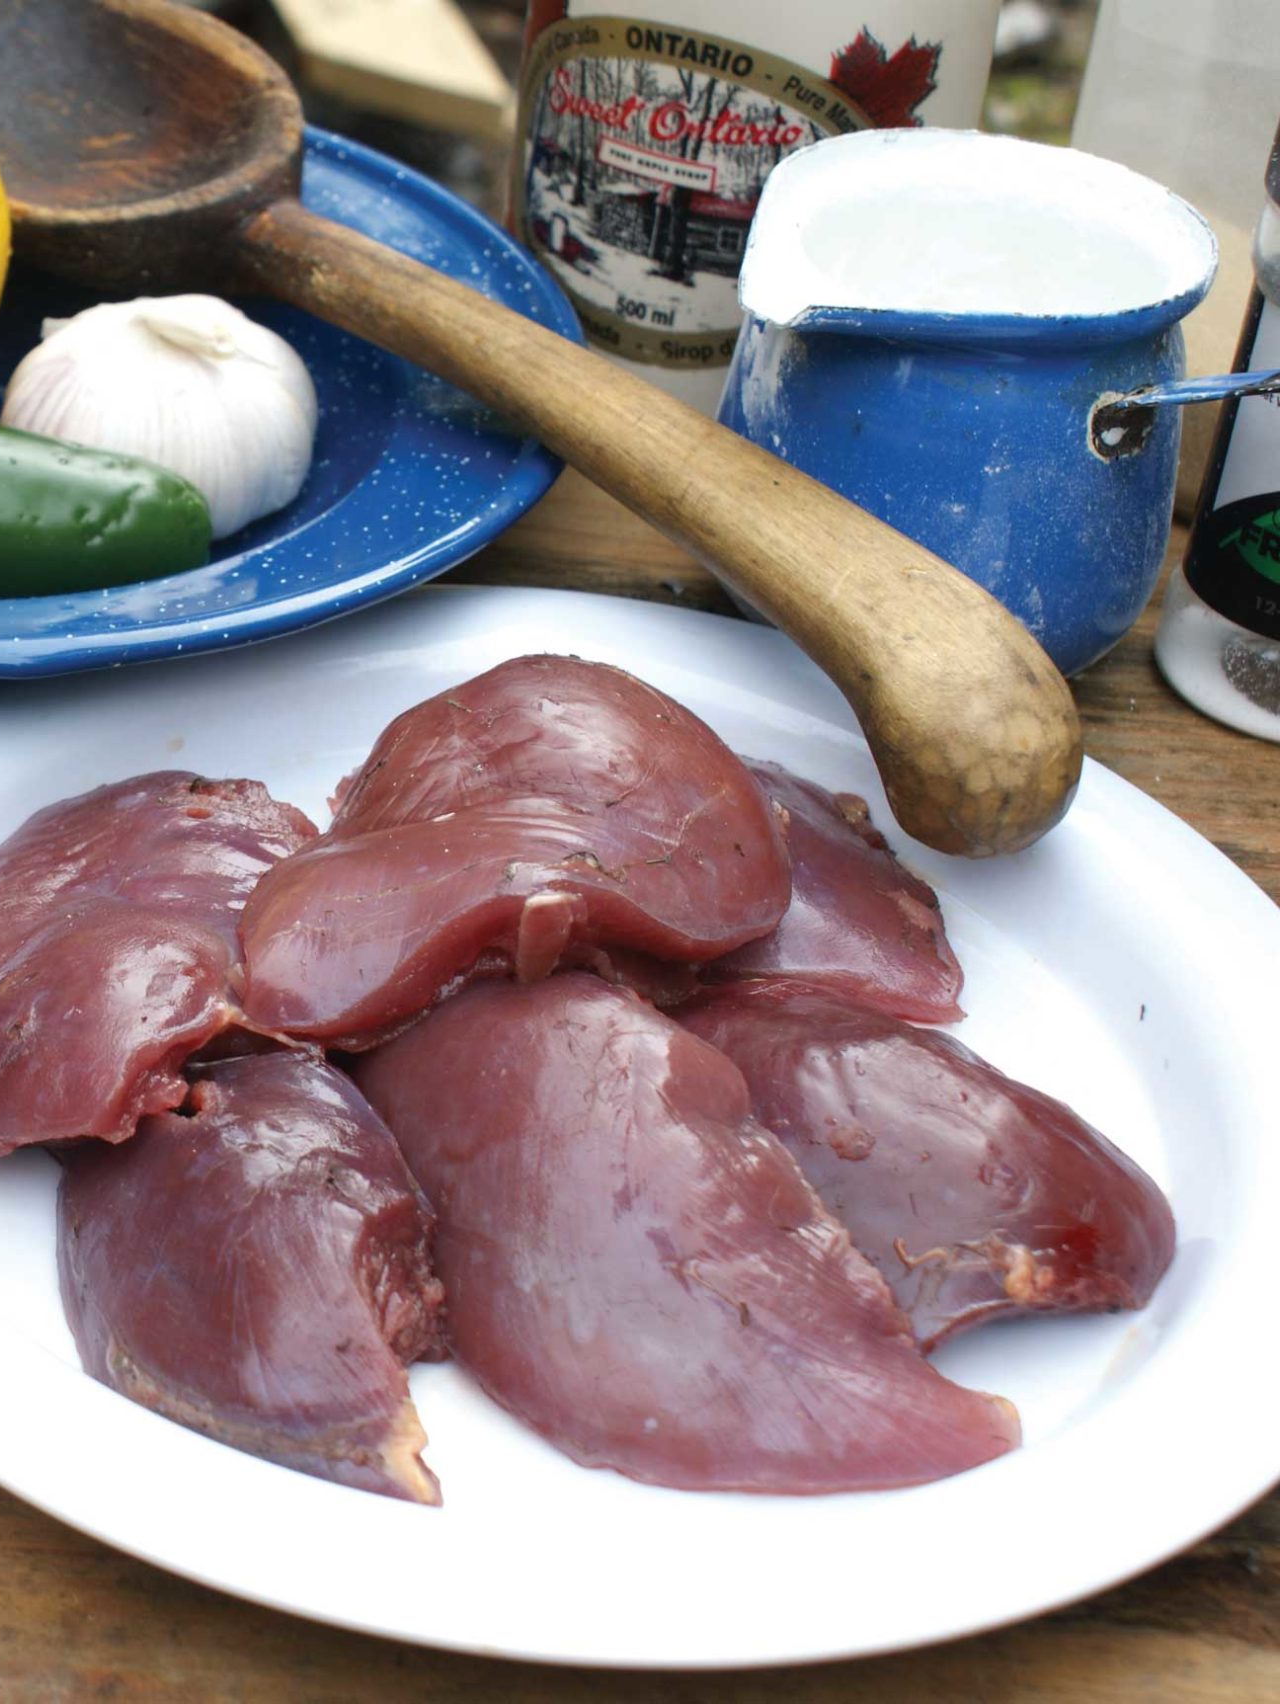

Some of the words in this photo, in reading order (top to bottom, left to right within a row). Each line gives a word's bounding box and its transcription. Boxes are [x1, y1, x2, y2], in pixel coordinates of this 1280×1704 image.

[625, 25, 754, 77] ONTARIO
[783, 75, 827, 111] Pure
[549, 66, 646, 131] Sweet
[648, 100, 803, 146] Ontario
[616, 294, 647, 321] 500
[651, 309, 676, 327] ml
[660, 338, 714, 365] Sirop
